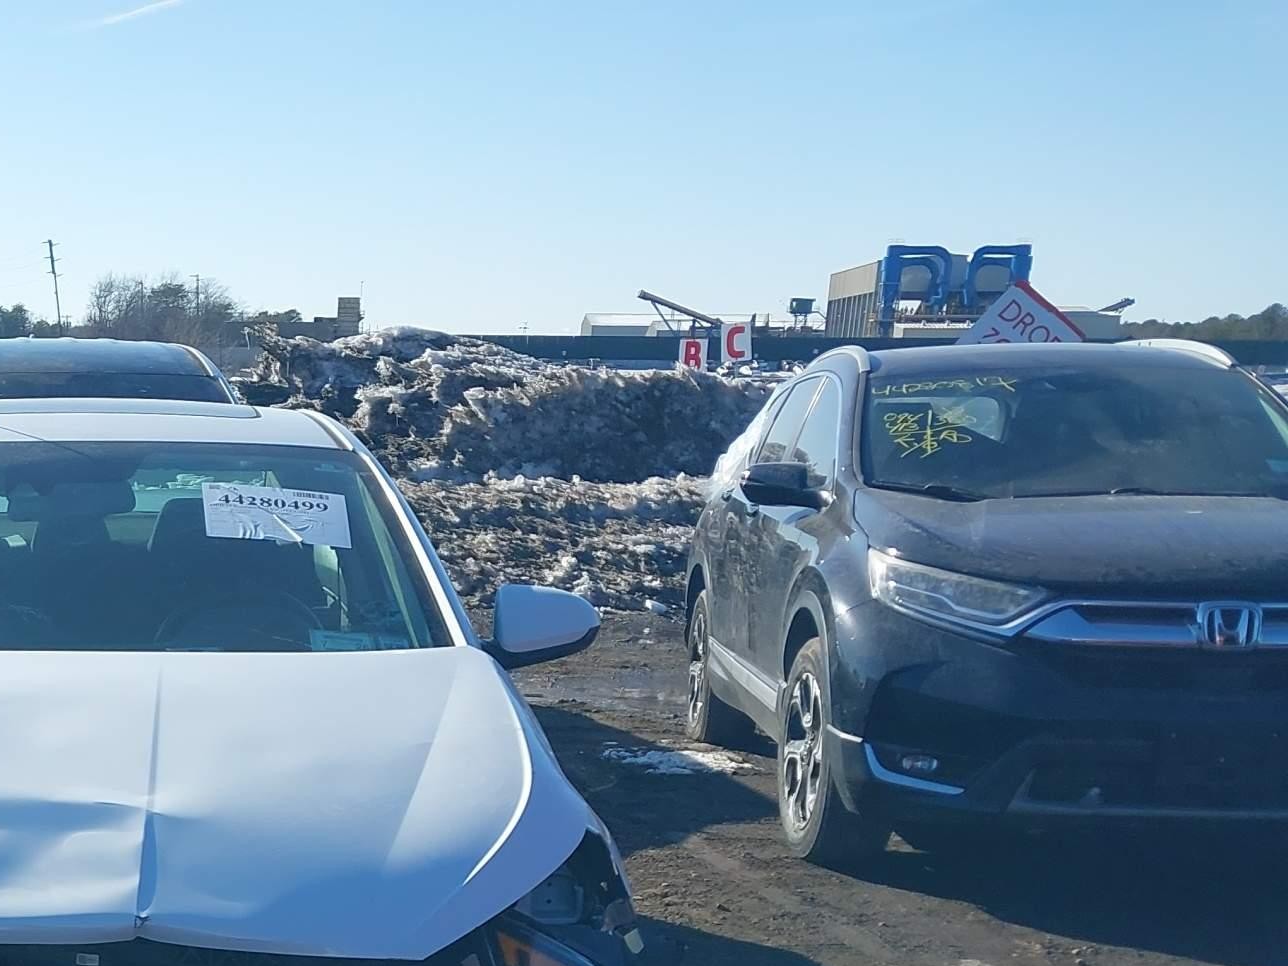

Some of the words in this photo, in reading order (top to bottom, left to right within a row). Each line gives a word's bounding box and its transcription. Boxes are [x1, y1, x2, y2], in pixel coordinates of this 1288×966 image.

[998, 299, 1061, 342] DRO
[726, 325, 746, 358] C
[218, 493, 329, 513] 44280499
